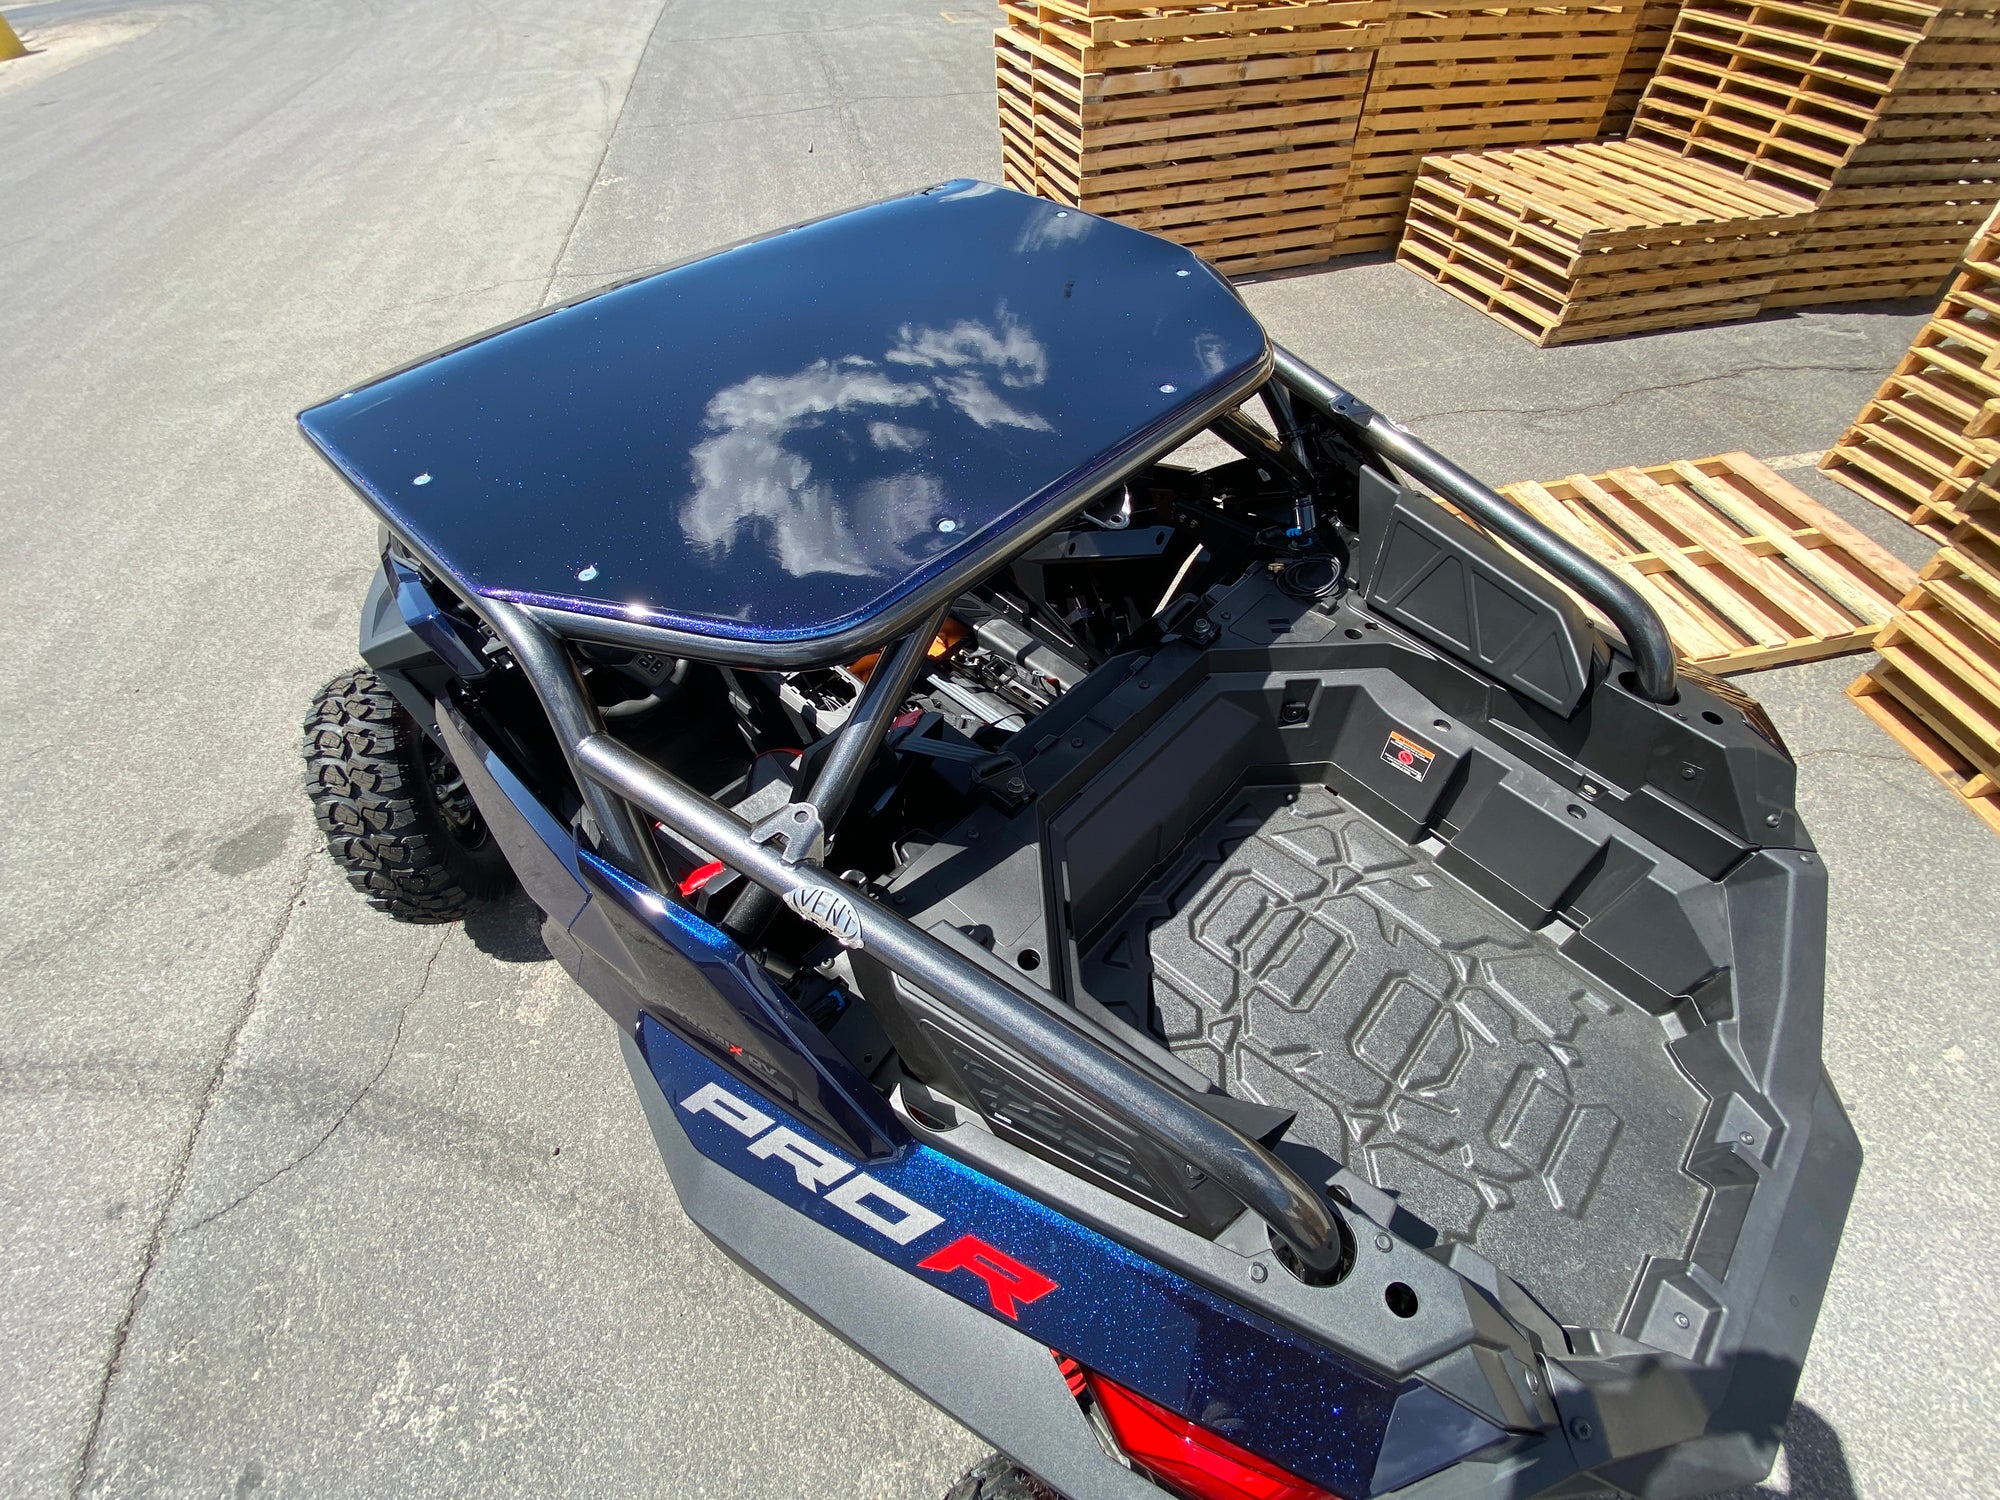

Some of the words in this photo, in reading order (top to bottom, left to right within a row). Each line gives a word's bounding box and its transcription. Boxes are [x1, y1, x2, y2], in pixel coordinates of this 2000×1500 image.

[801, 889, 856, 933] VENT
[681, 1082, 946, 1245] PRO
[917, 1234, 1058, 1321] R
